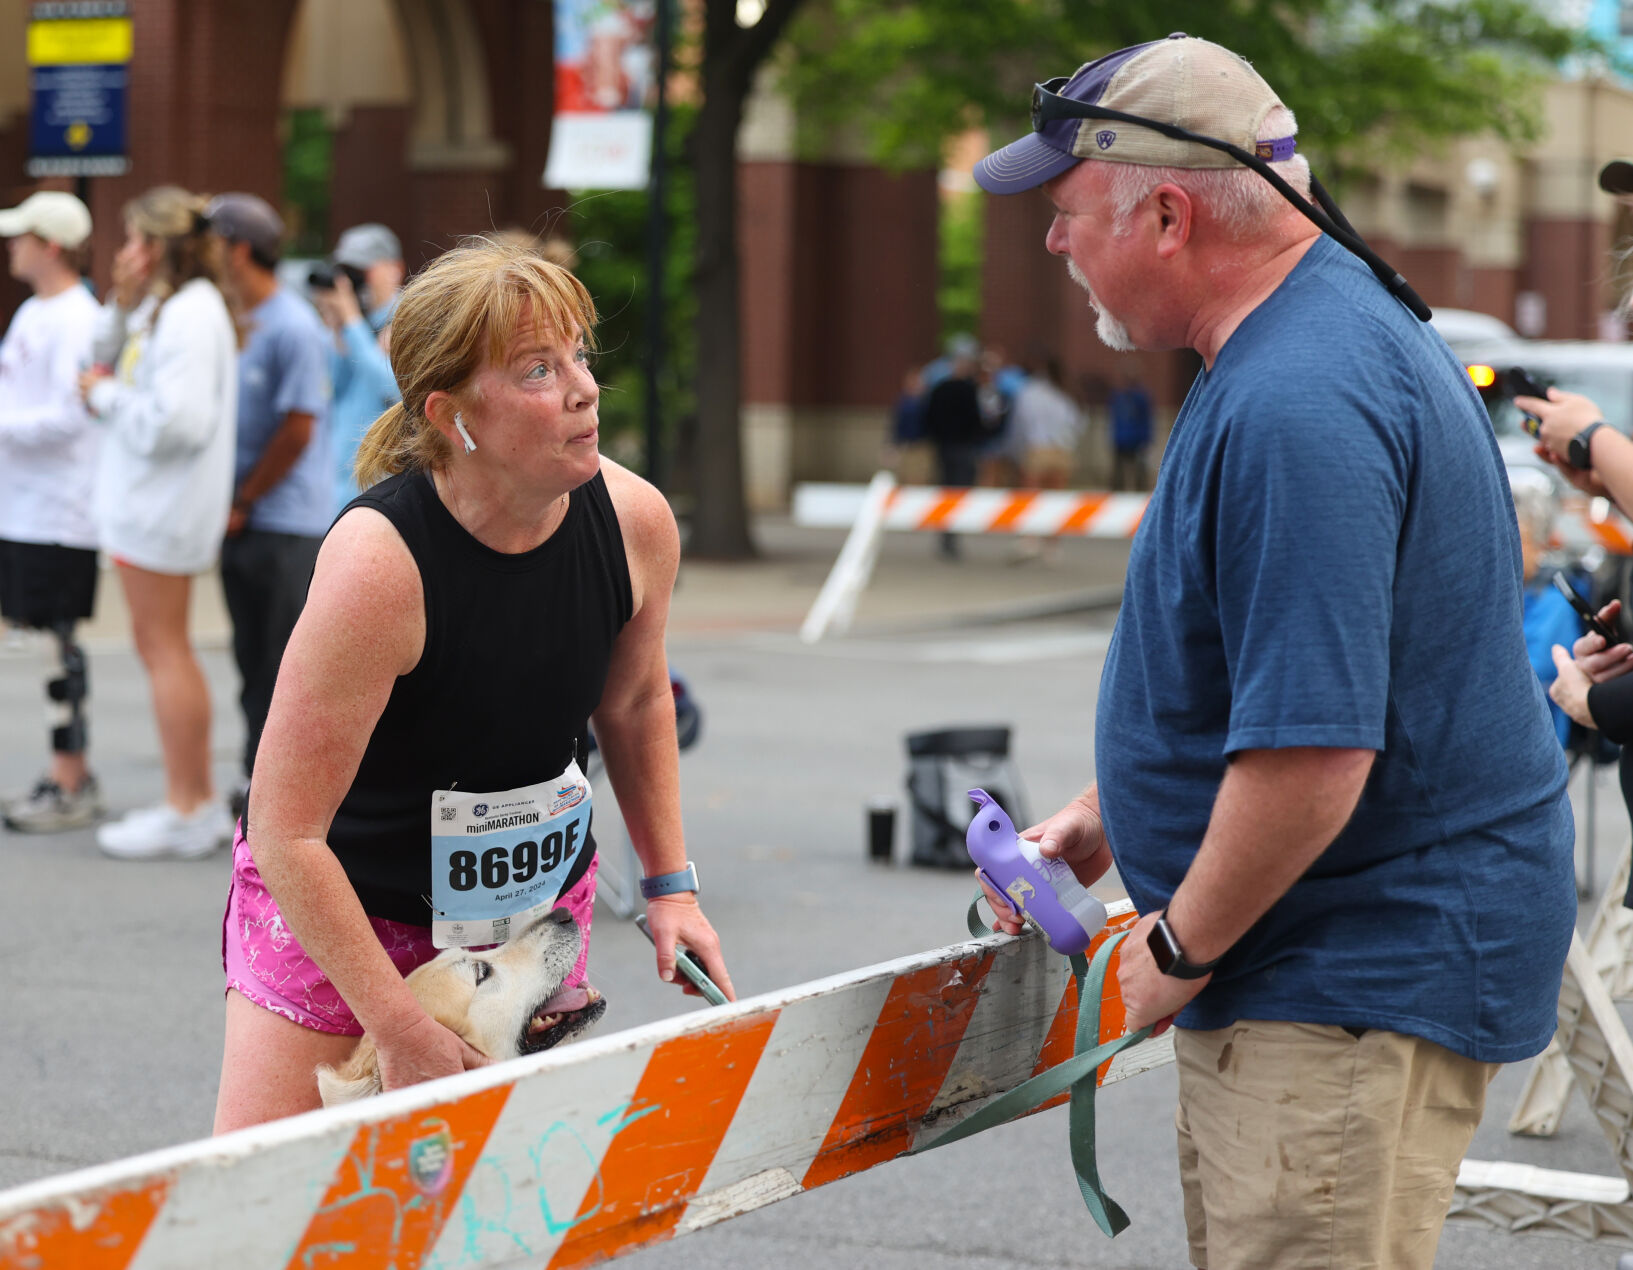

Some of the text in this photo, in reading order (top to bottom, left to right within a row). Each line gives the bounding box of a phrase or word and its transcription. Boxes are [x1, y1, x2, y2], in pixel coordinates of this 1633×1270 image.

[466, 812, 540, 834] miniMARATHON
[449, 818, 580, 892] 8699E
[495, 880, 546, 901] April 27, 2024
